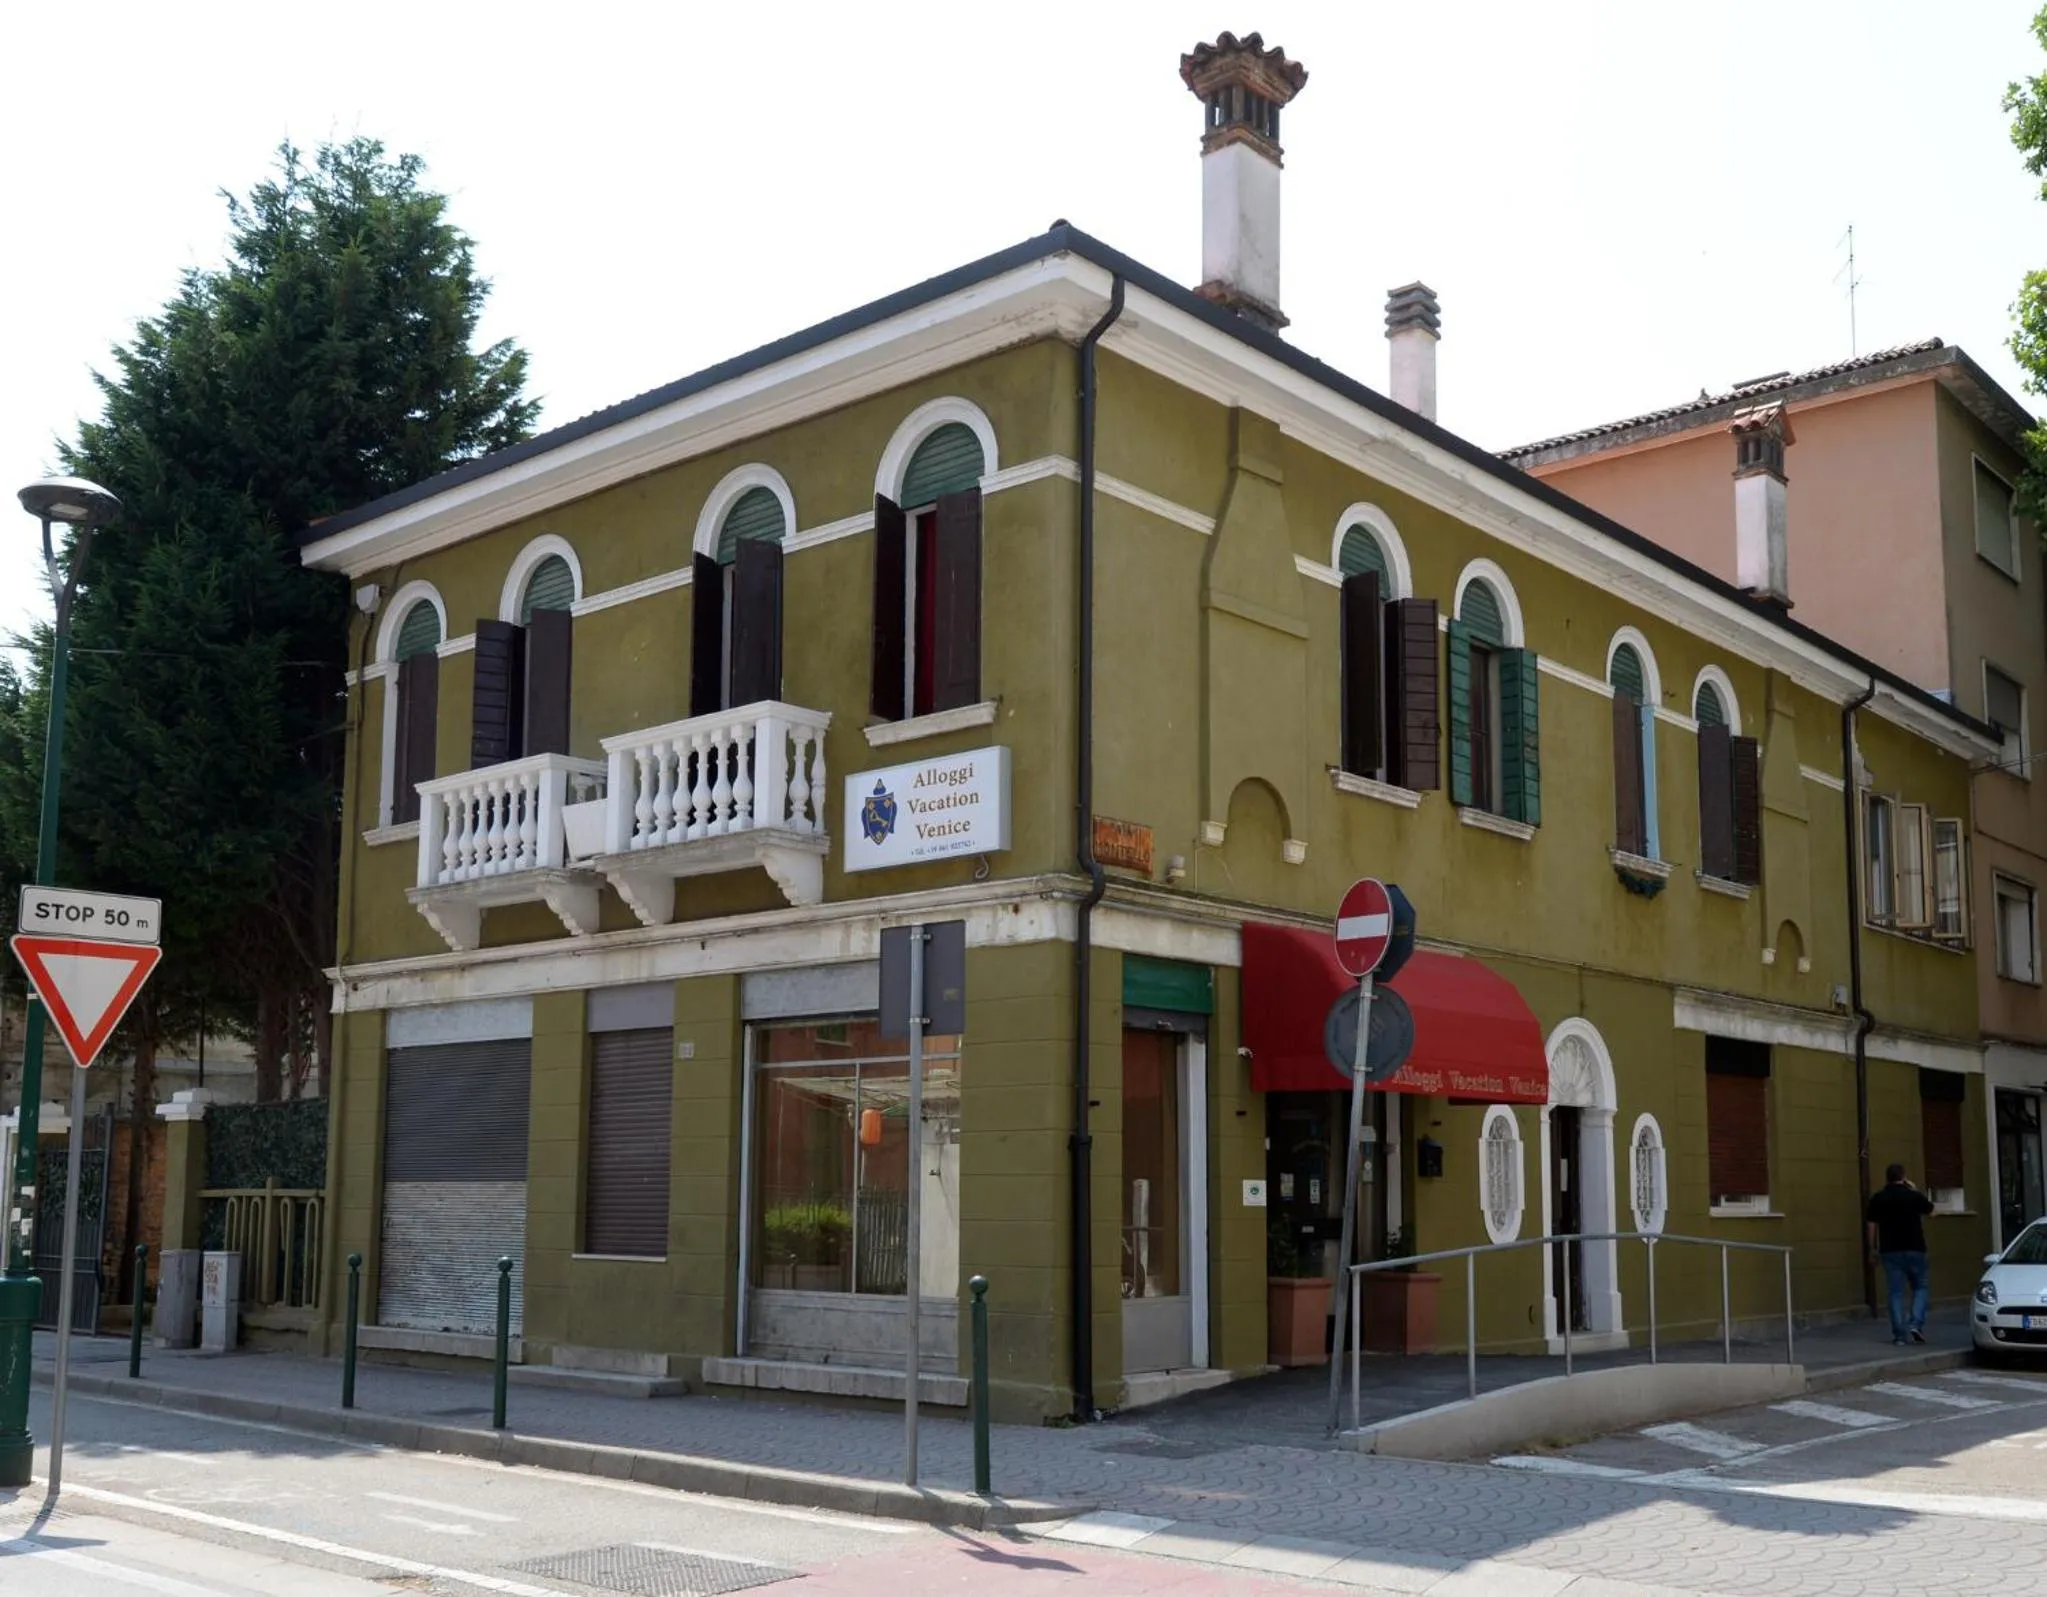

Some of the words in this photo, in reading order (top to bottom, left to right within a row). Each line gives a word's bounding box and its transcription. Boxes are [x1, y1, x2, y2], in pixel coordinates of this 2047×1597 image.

[913, 763, 975, 789] Alloggi
[907, 791, 980, 815] Vacation
[916, 818, 971, 840] Venice
[35, 902, 95, 923] STOP
[104, 910, 130, 927] 50
[136, 918, 149, 930] m
[1391, 1064, 1443, 1093] Alloggi
